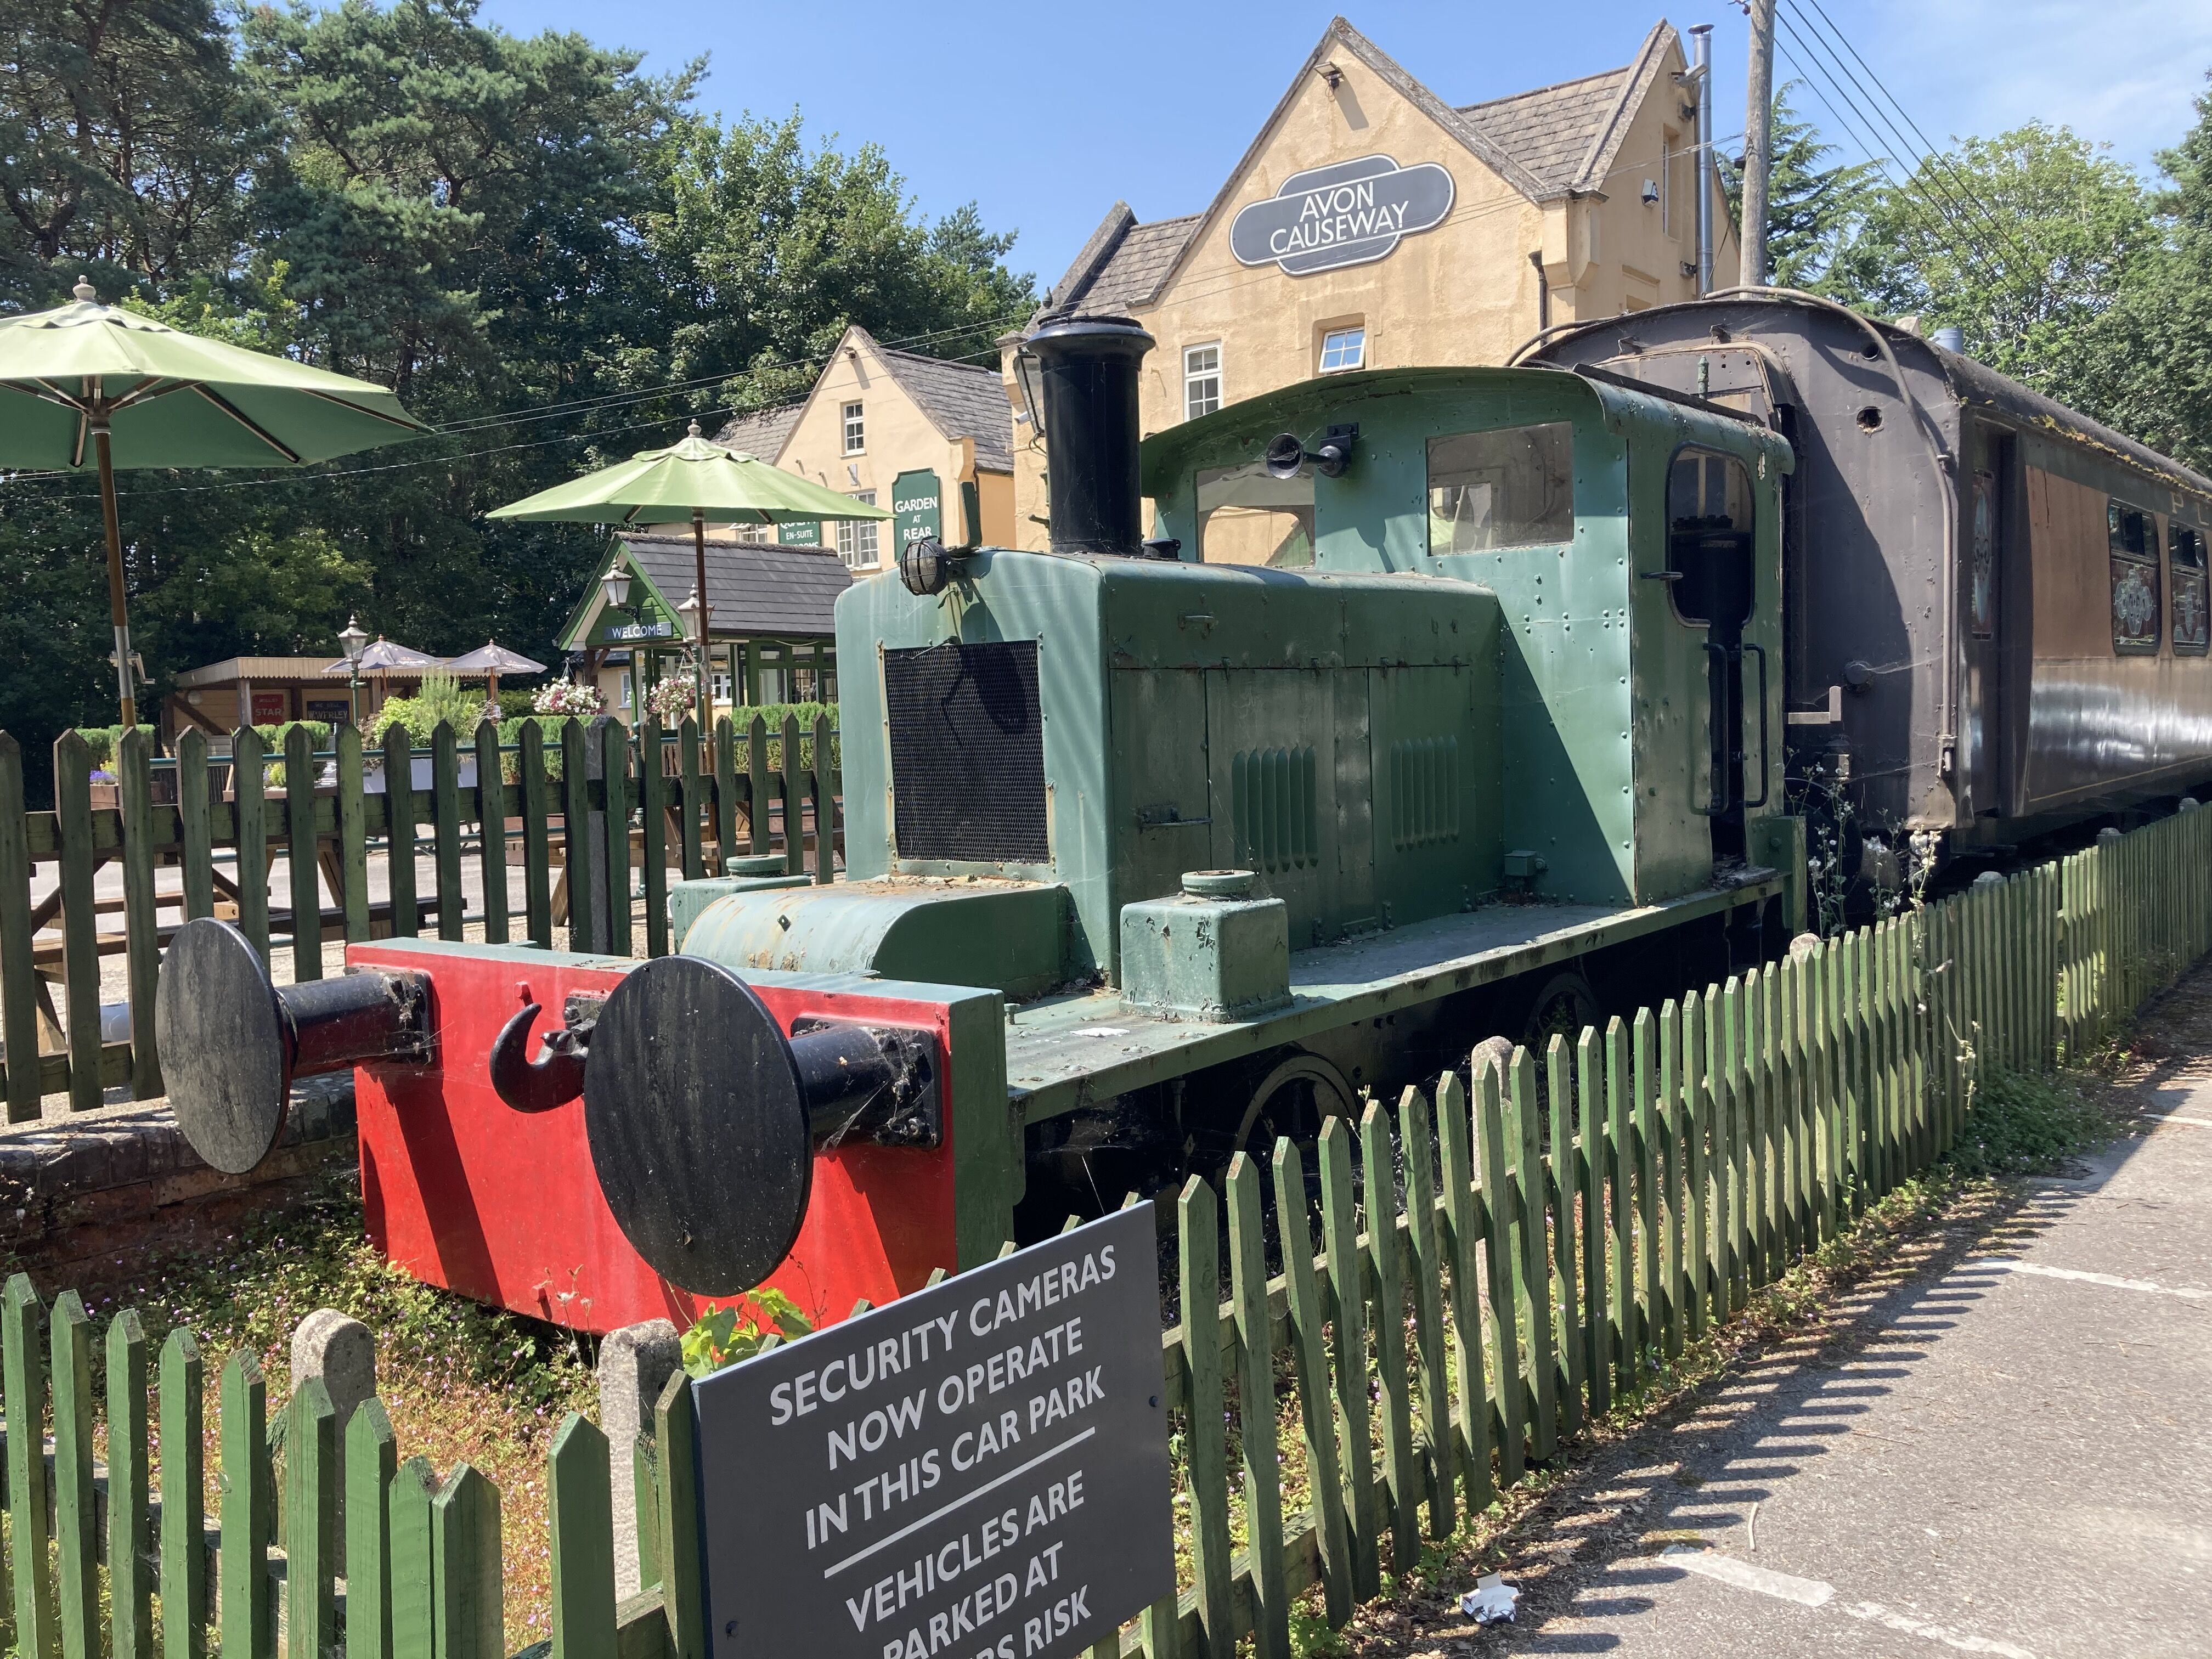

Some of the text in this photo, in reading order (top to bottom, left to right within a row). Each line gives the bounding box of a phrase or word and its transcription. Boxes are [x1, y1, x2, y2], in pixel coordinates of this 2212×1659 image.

[1269, 200, 1409, 255] CAUSEWAY
[1299, 182, 1374, 222] AVON
[895, 496, 938, 513] GARDEN
[912, 515, 922, 524] AT
[786, 529, 814, 540] EN-SUITE
[903, 526, 932, 540] REAR
[612, 624, 662, 639] WELCOME
[770, 1244, 1116, 1426] SECURITY CAMERAS
[827, 1316, 1083, 1471] NOW OPERATE
[806, 1364, 1105, 1550] IN THIS CAR PARK
[845, 1469, 1085, 1633] VEHICLES ARE
[883, 1540, 1063, 1659] PARKED AT
[1024, 1584, 1092, 1658] RISK
